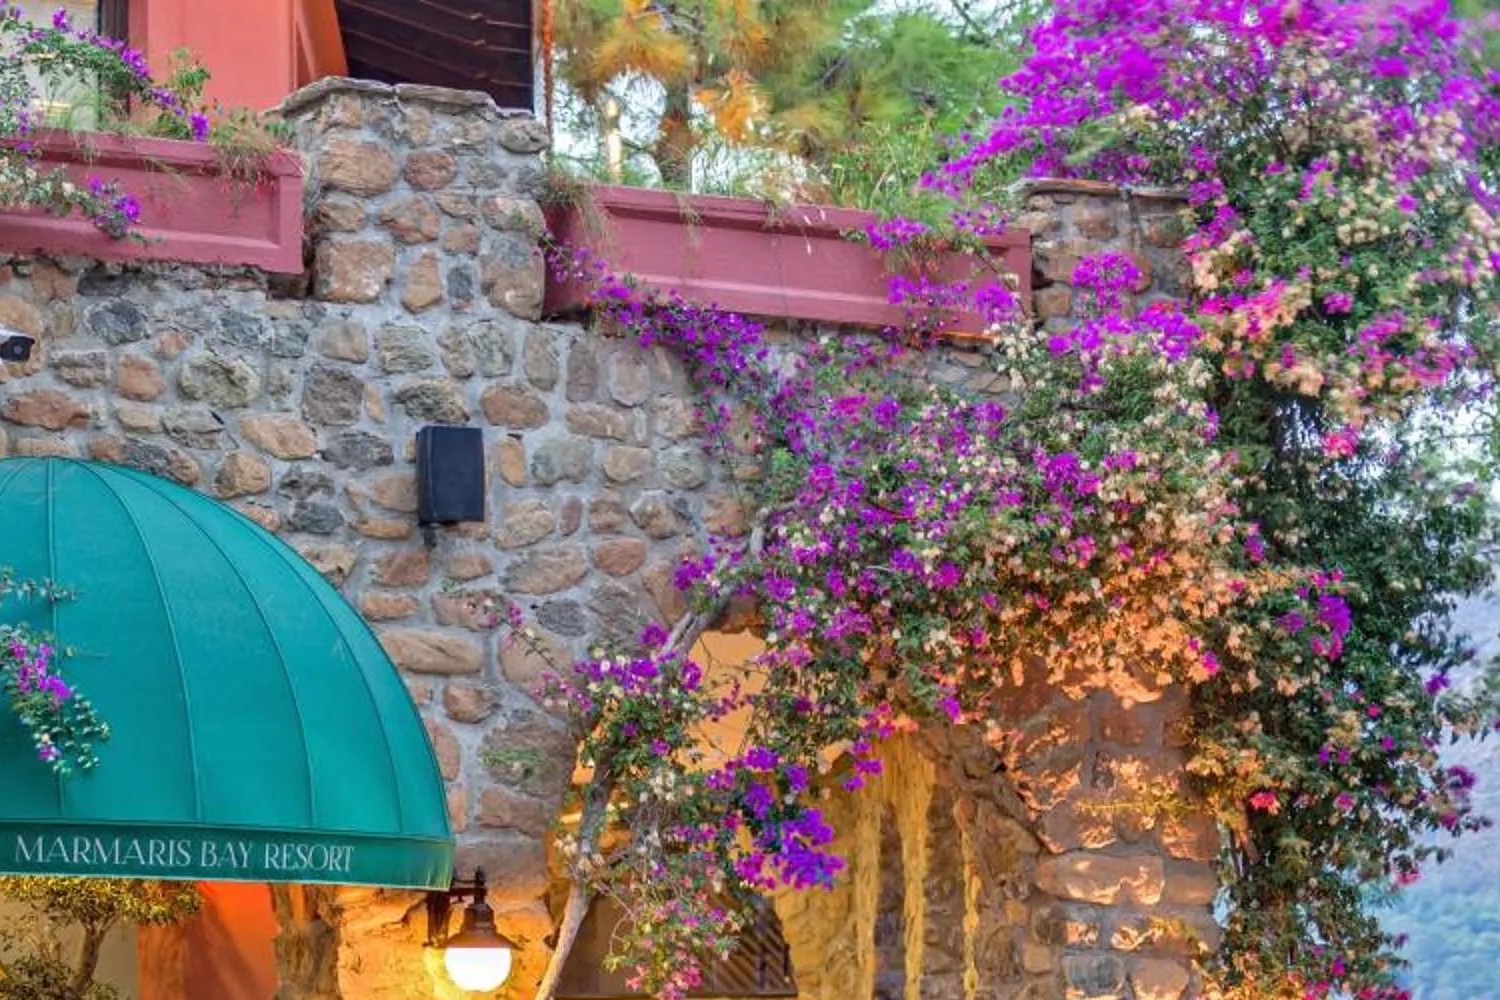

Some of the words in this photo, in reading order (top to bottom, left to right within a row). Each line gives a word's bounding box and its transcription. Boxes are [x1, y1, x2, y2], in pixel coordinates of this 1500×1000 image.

[15, 835, 191, 866] MARMARIS
[200, 840, 253, 868] BAY
[263, 844, 355, 872] RESORT
